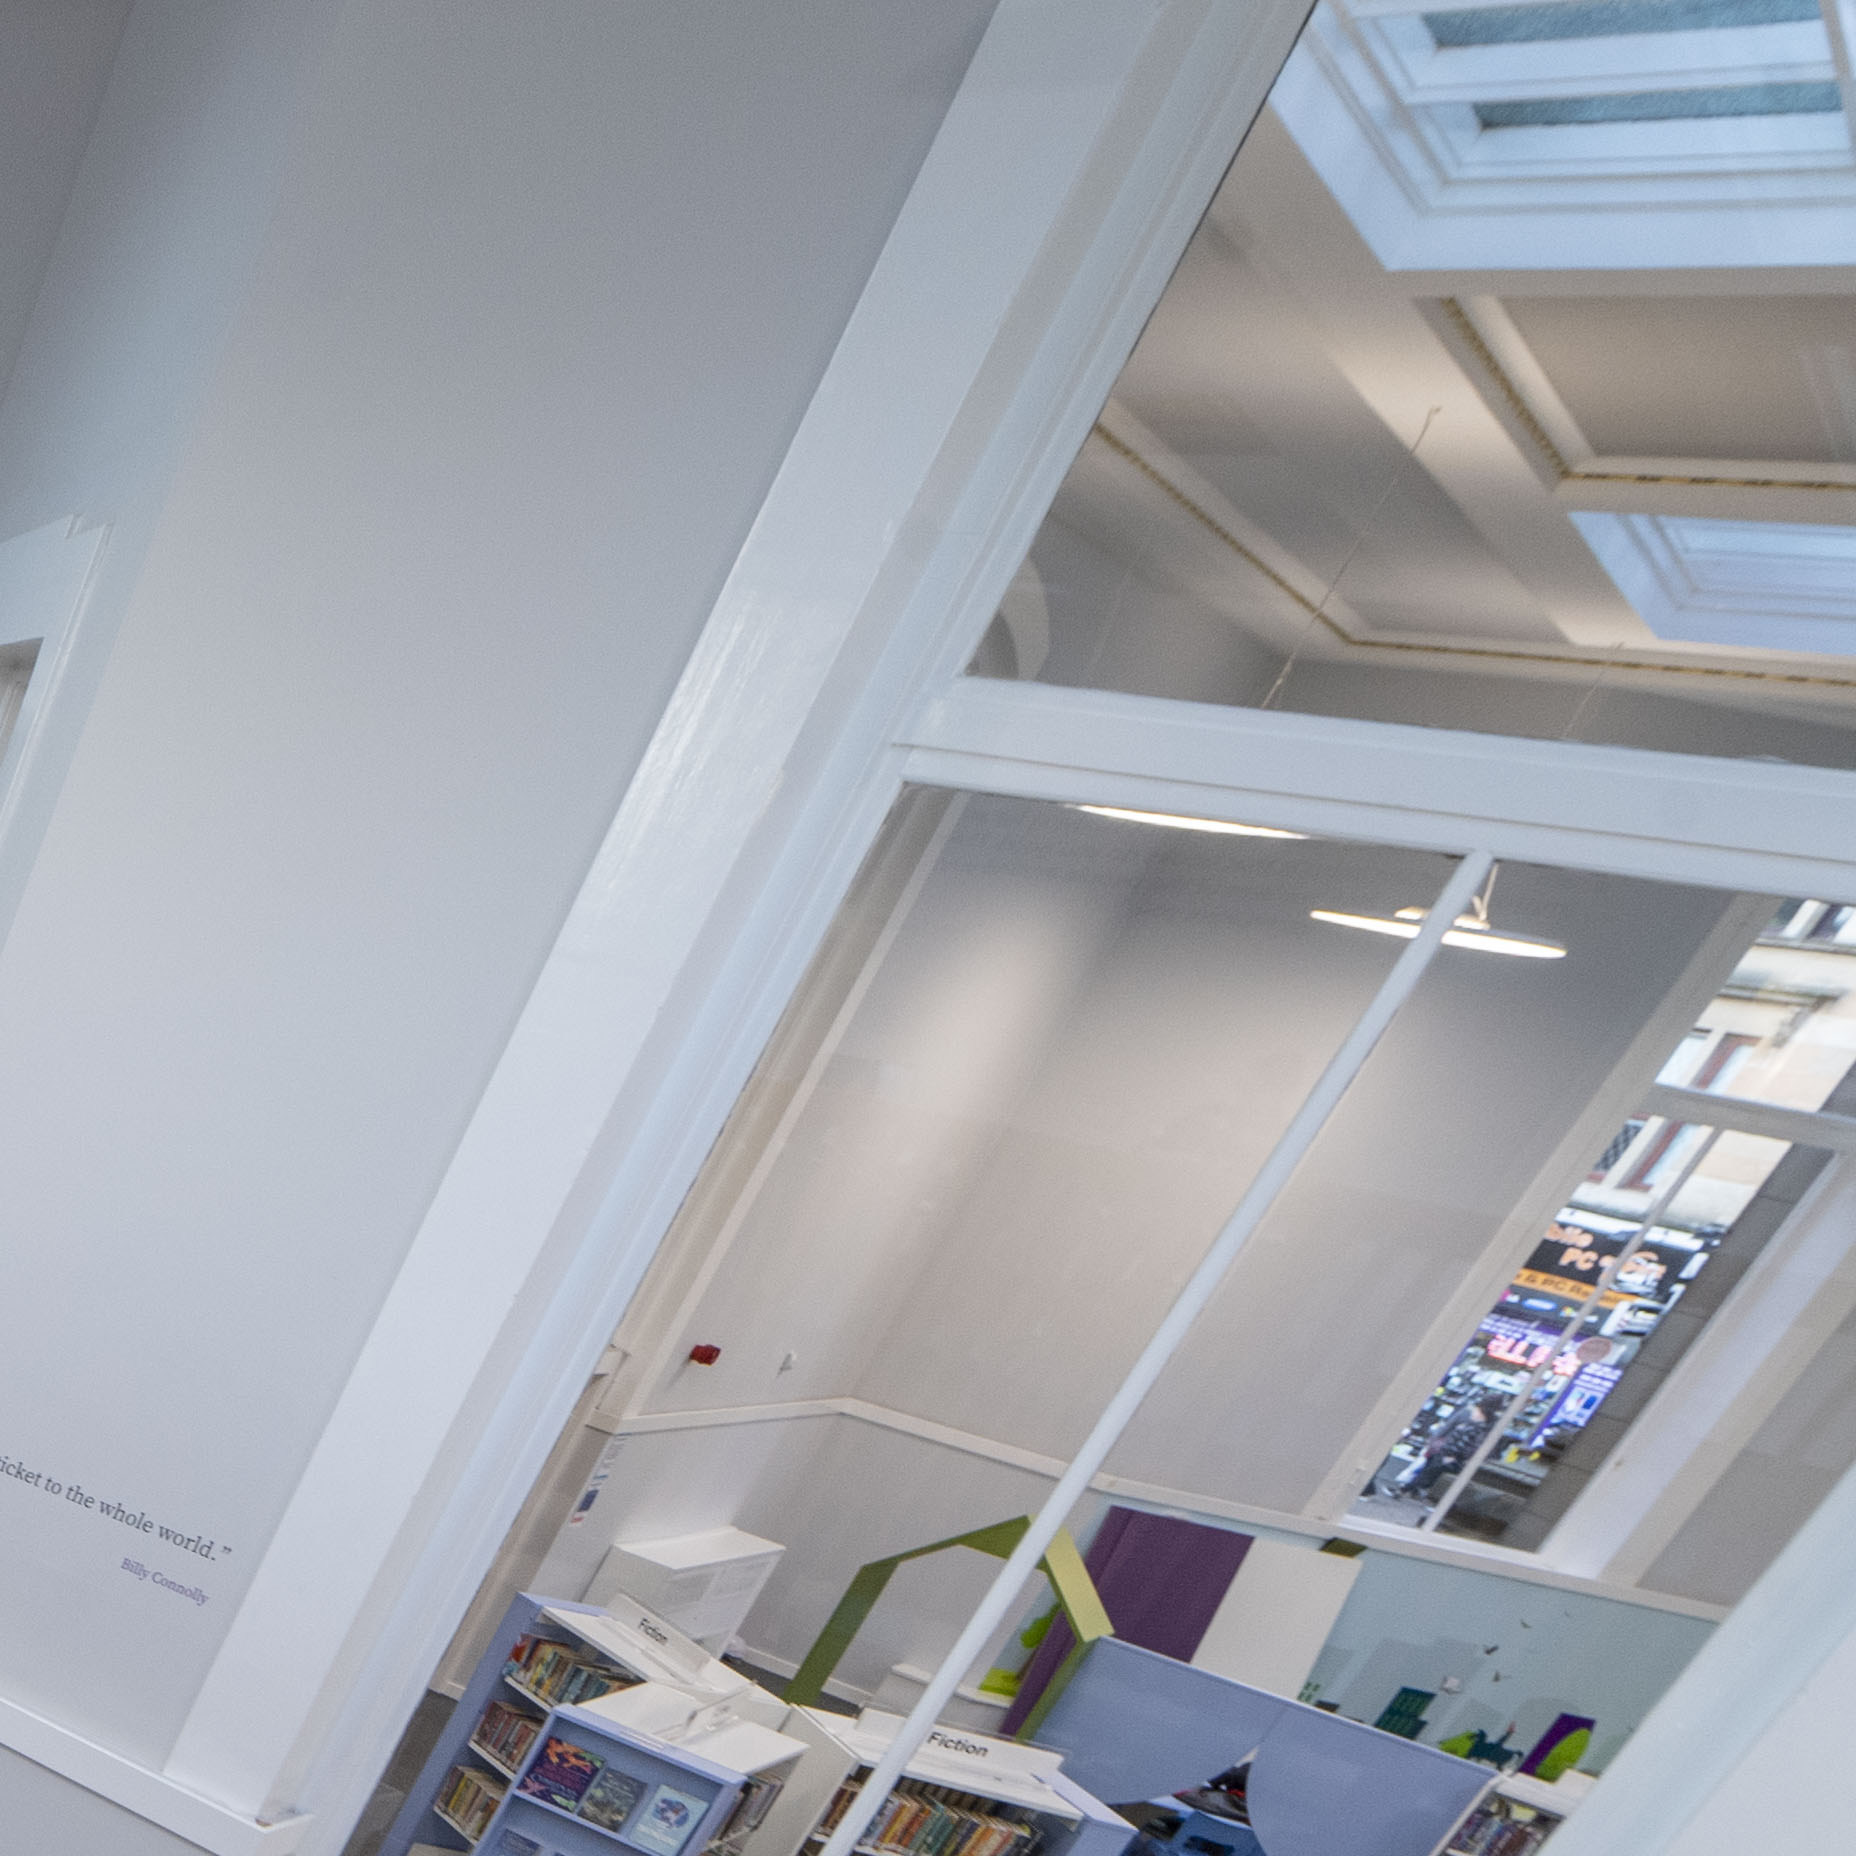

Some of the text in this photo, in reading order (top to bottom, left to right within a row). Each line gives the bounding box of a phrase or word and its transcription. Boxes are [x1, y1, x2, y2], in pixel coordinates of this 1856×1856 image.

[43, 1477, 63, 1496] to
[65, 1484, 96, 1510] the
[99, 1500, 155, 1534] whole
[120, 1556, 210, 1607] Billy Connolly
[638, 1616, 669, 1647] Fiction
[927, 1731, 989, 1758] Fiction
